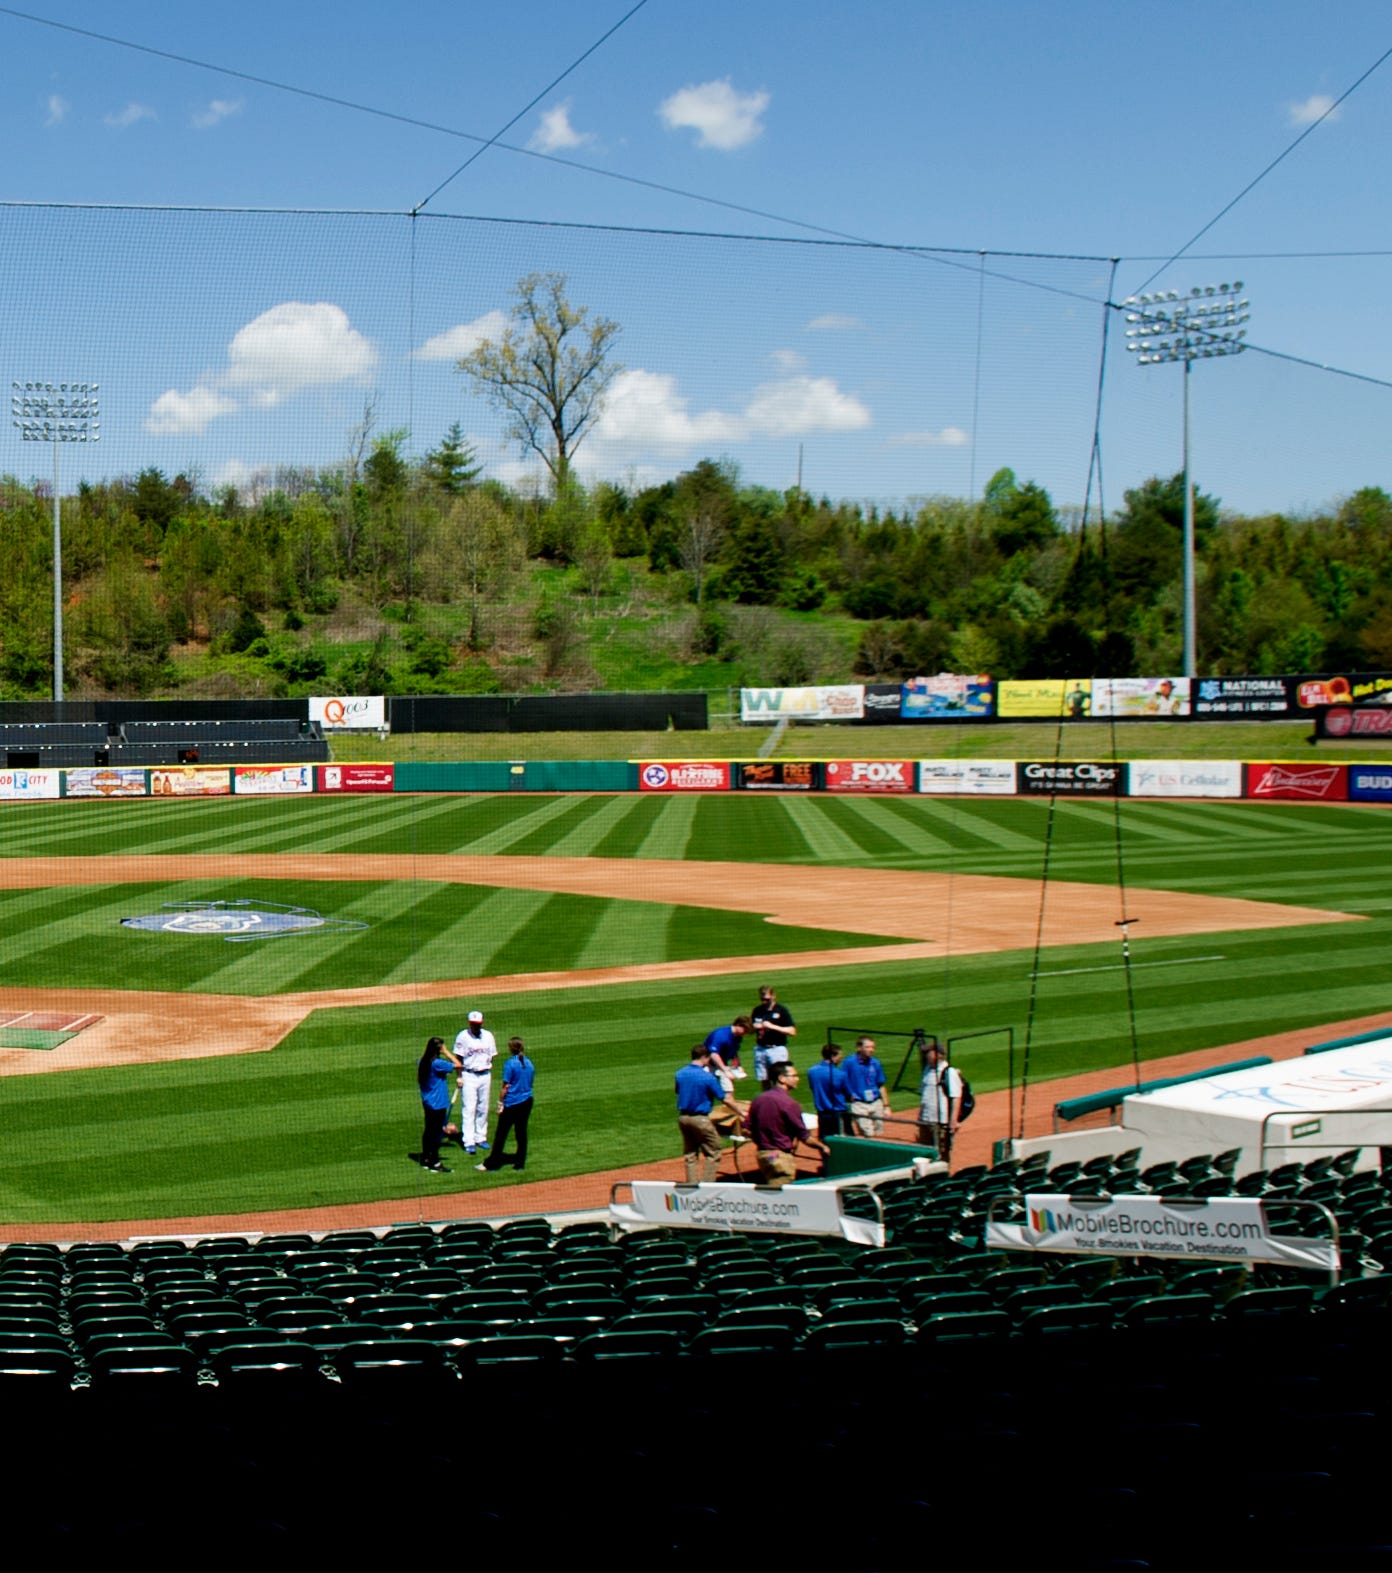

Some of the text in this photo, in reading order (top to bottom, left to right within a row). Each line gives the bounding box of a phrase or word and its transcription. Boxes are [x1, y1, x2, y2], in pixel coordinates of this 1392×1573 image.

[1222, 680, 1286, 691] NATIONAL
[782, 763, 812, 777] FREE
[851, 763, 905, 781] FOX
[1024, 764, 1117, 783] Great Clips
[28, 775, 48, 785] CITY
[1179, 774, 1230, 786] Cellular
[1262, 772, 1331, 787] Budweiser
[679, 1196, 800, 1217] MobileBrochure.com
[1056, 1213, 1264, 1240] MobileBrochure.com
[1073, 1237, 1249, 1255] Your Smokies Vacation Destination
